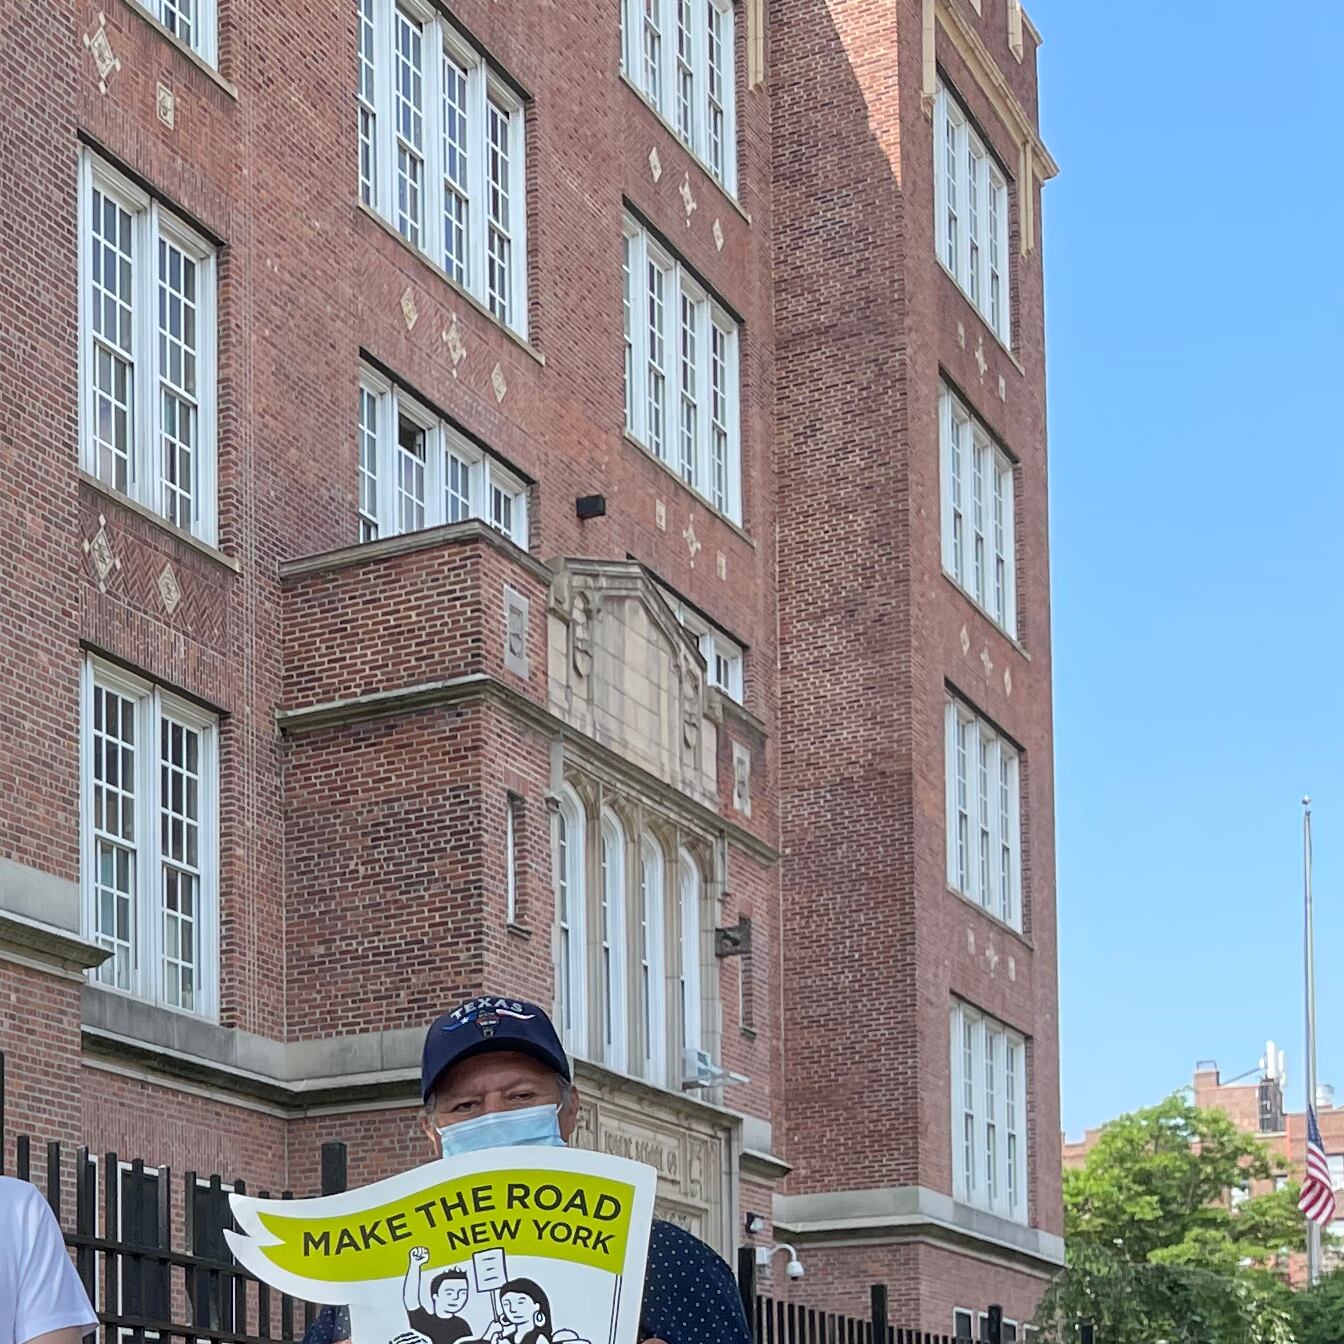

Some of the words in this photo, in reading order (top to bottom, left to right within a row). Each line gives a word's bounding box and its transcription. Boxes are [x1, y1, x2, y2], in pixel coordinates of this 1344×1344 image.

[450, 997, 523, 1019] TEXAS
[303, 1213, 413, 1257] MAKE
[414, 1183, 495, 1228] THE
[506, 1182, 622, 1222] ROAD
[446, 1218, 523, 1250] NEW
[532, 1219, 617, 1255] YORK
